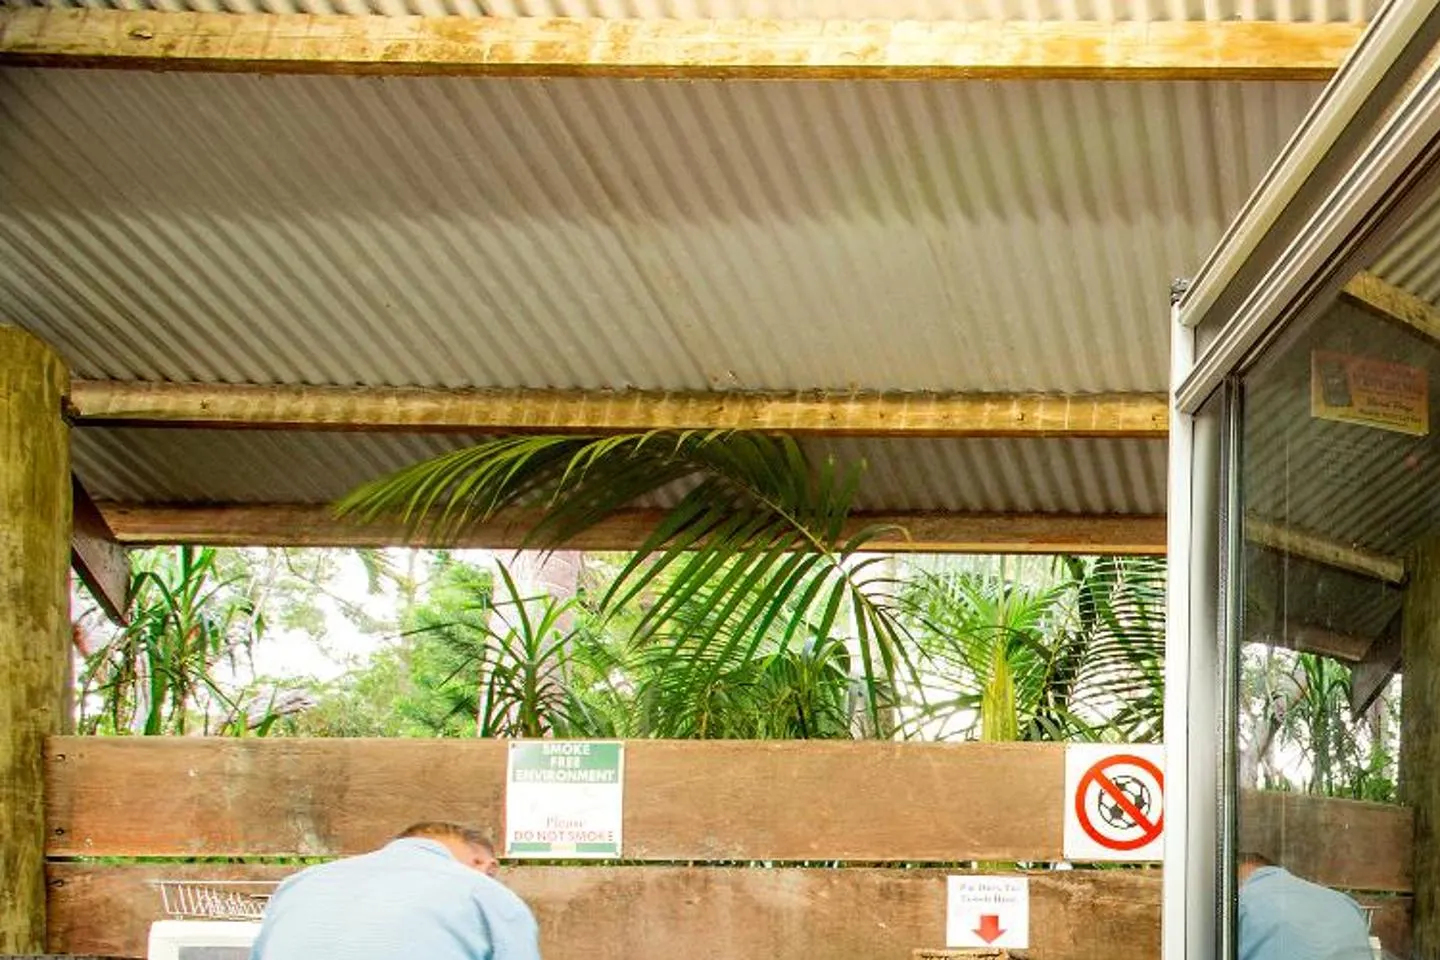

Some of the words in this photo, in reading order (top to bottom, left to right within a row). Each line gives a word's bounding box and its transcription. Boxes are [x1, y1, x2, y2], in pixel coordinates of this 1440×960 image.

[542, 743, 591, 755] SMOKE
[551, 756, 580, 768] FREE
[515, 769, 616, 781] ENVIRONMENT
[514, 830, 534, 841] DO
[537, 830, 564, 841] NOT
